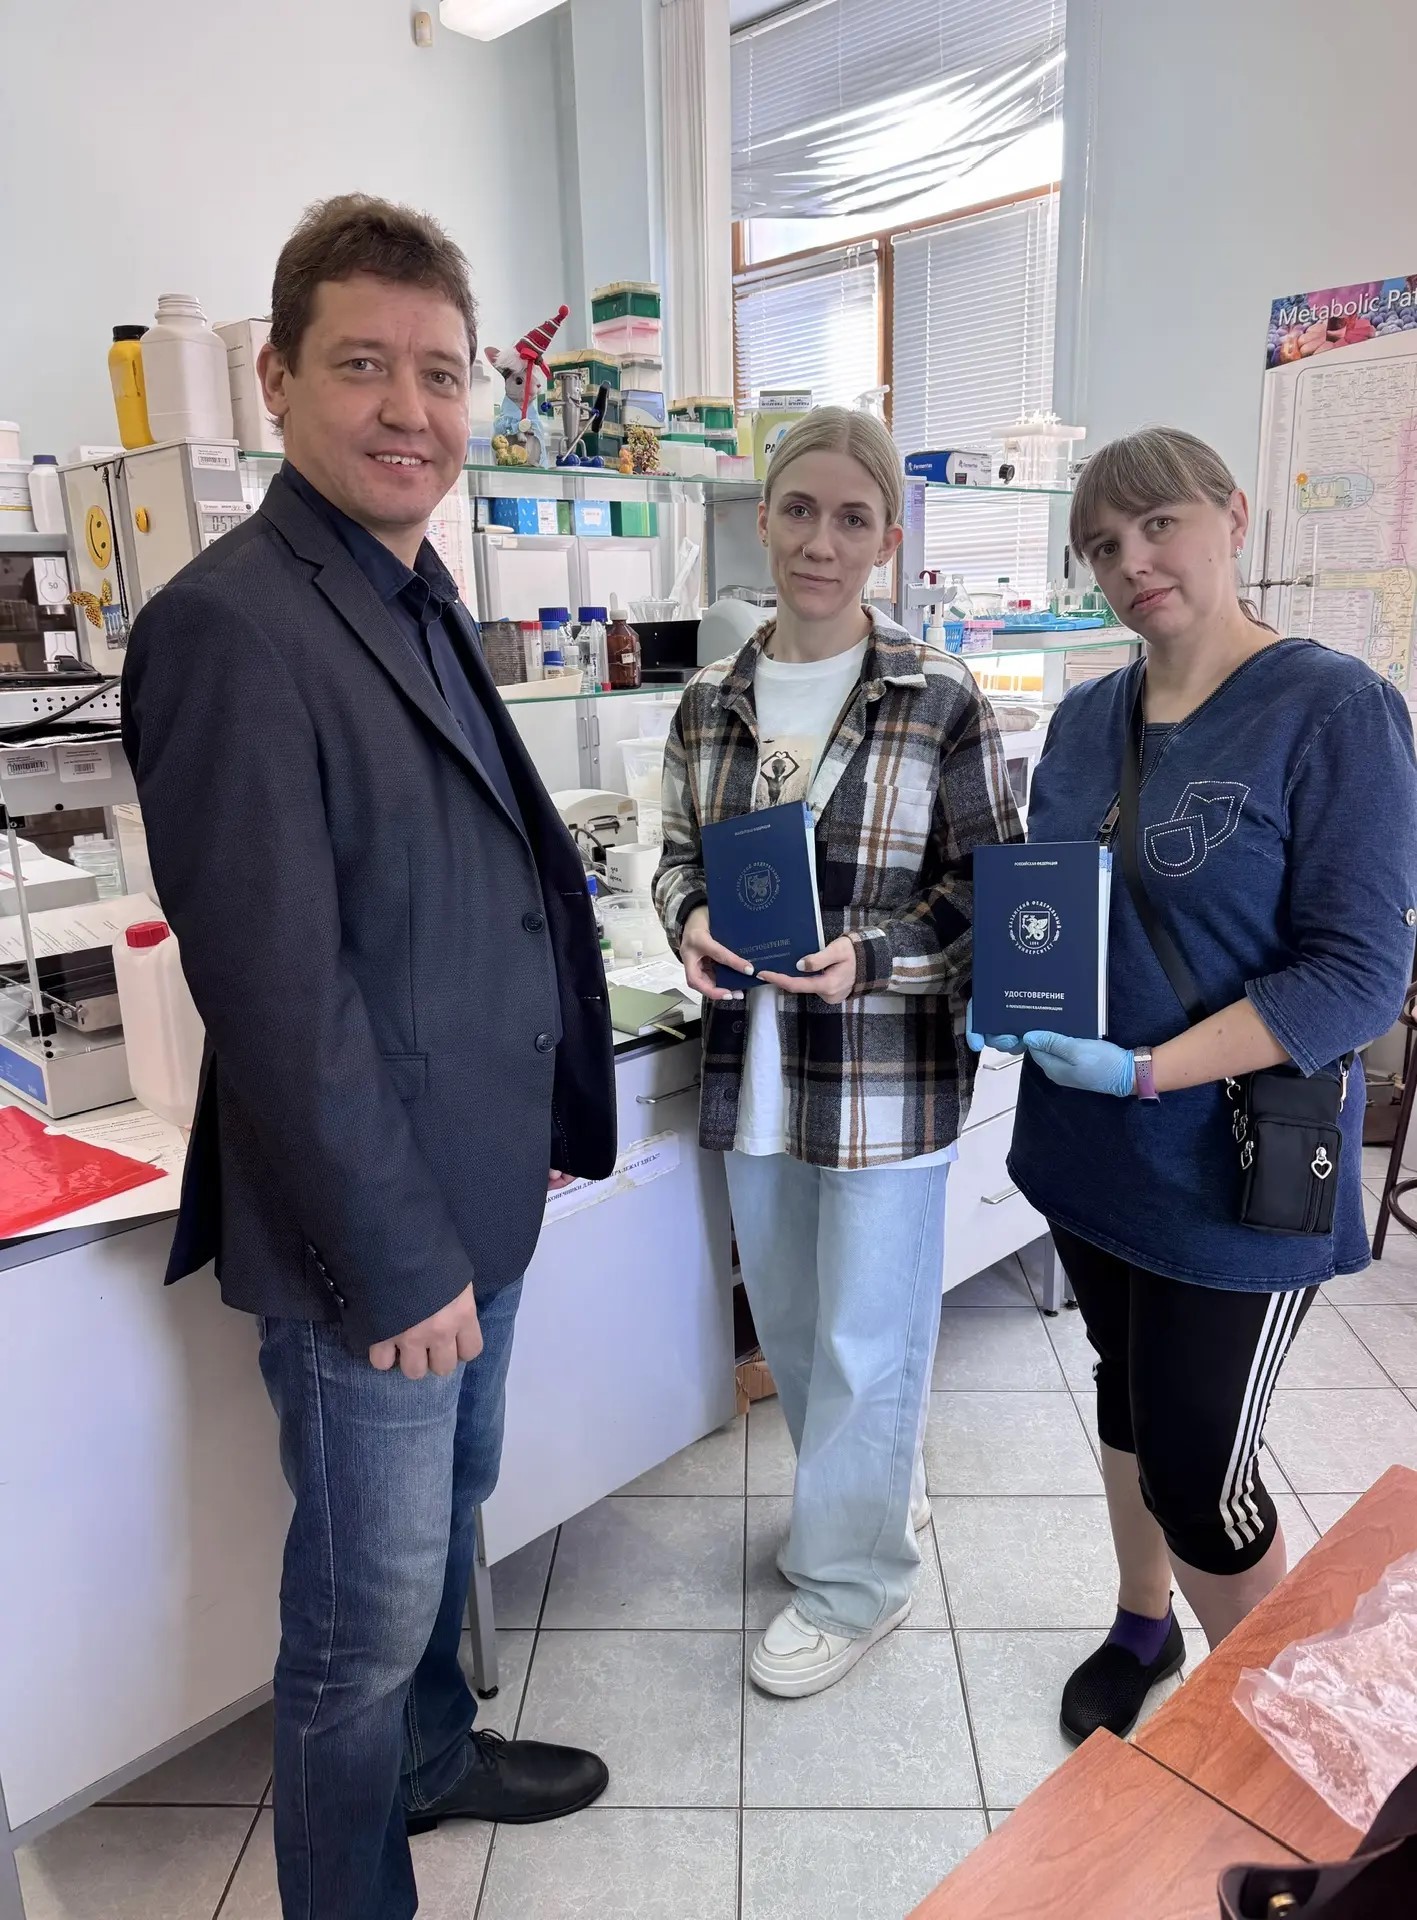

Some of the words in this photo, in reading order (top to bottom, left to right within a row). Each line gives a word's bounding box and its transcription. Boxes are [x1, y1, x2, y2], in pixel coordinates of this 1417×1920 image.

[1278, 293, 1380, 326] Metabolic
[48, 581, 59, 590] 50
[1015, 941, 1054, 955] УНИВЕРСИТЕТ
[1003, 990, 1065, 1000] УДОСТОВЕРЕНИЕ
